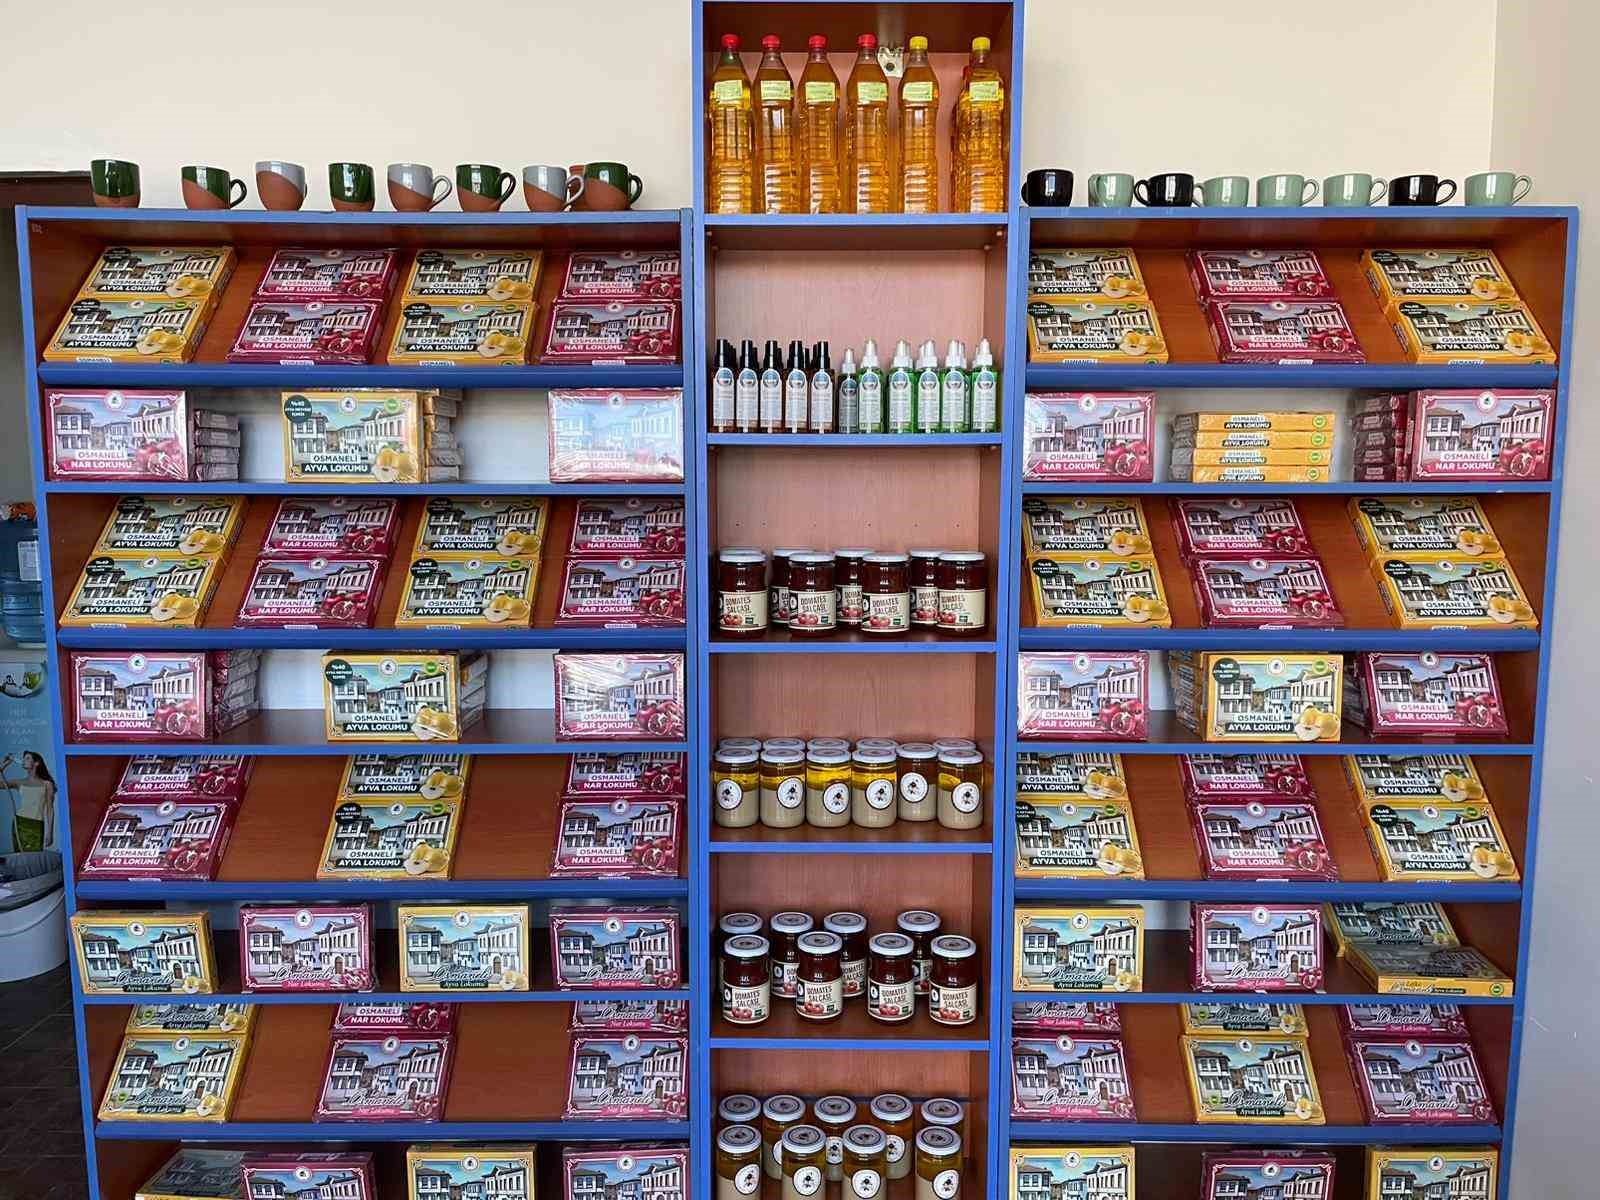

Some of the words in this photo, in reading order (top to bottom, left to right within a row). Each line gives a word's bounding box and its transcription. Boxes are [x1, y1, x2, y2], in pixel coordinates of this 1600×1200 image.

[305, 464, 328, 472] AYVA
[330, 464, 368, 472] LOKUMU
[371, 723, 407, 731] LOKUMU
[1229, 723, 1251, 731] AYVA
